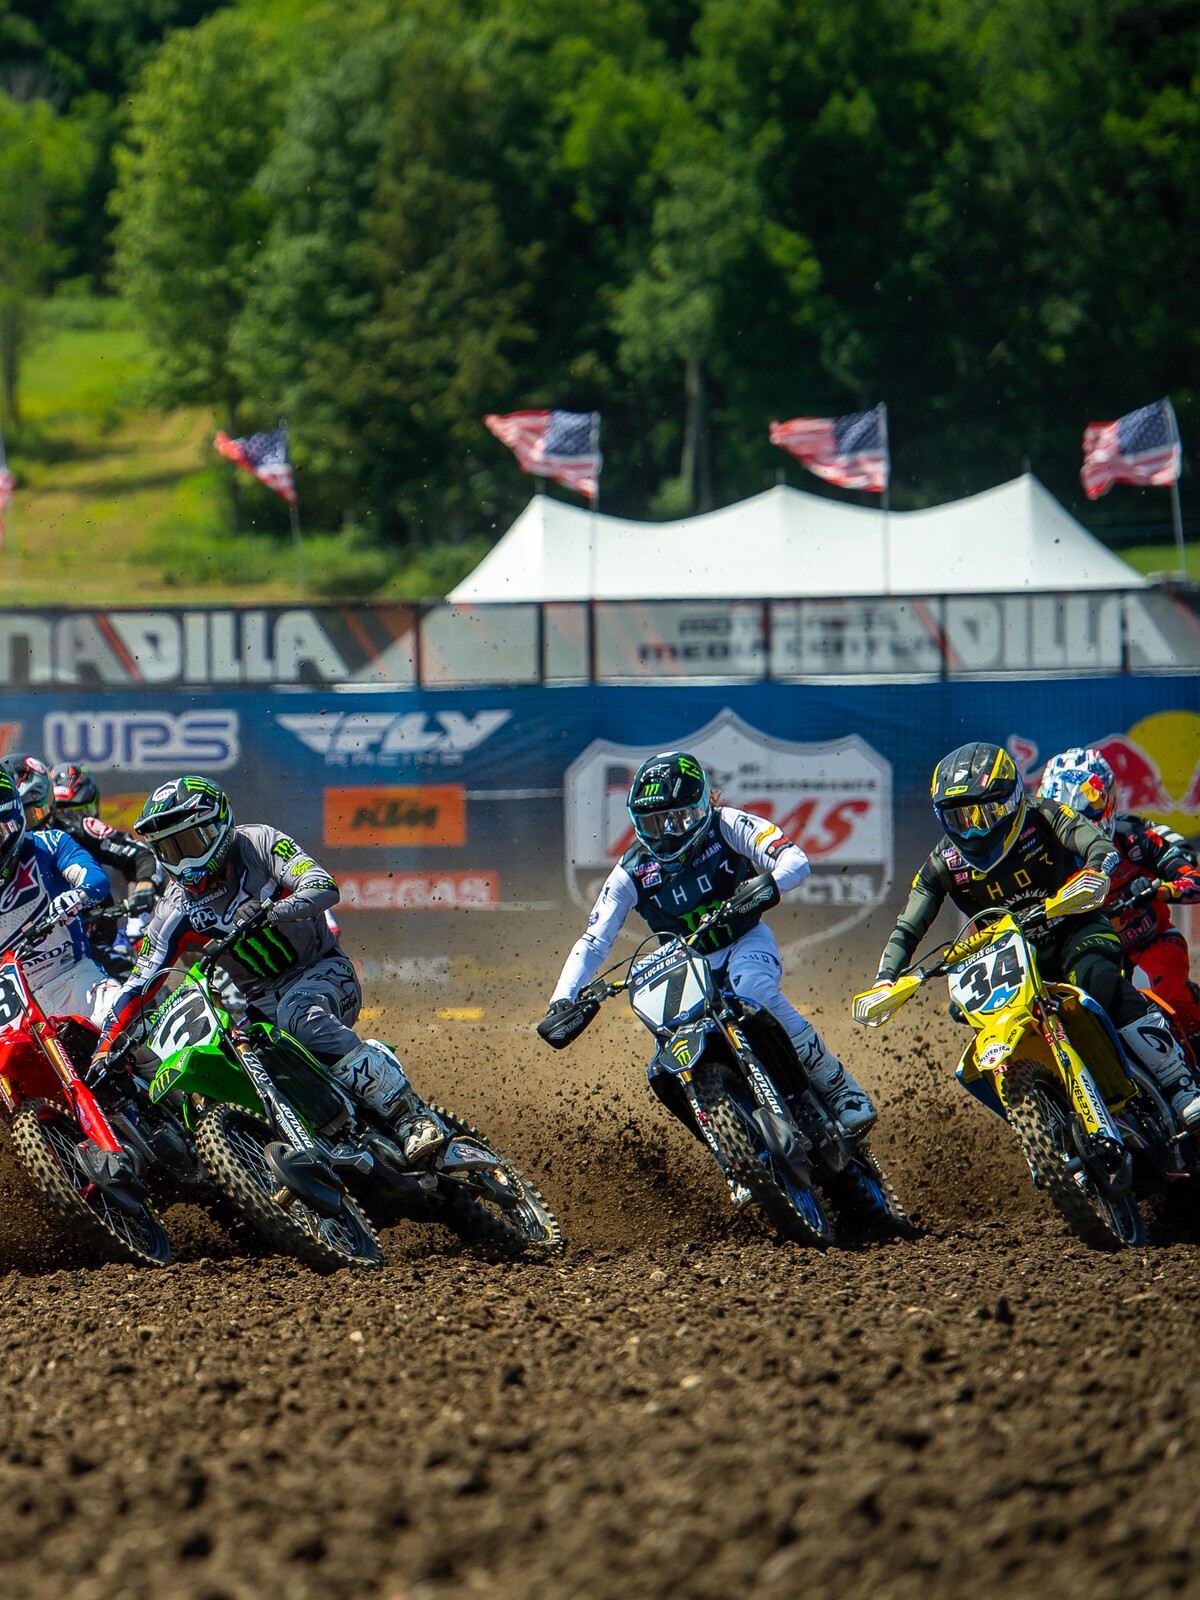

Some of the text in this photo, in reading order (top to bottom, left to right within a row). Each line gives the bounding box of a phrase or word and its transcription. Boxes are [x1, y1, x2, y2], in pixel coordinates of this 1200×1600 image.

[44, 711, 238, 772] WPS
[352, 806, 441, 829] KTM
[336, 877, 490, 909] ASGAS
[20, 940, 74, 970] ONDA
[643, 956, 678, 981] LUCAS OIL
[965, 944, 998, 967] LUCAS OIL
[649, 962, 688, 1026] 7
[959, 945, 1025, 1013] 34
[160, 996, 211, 1049] 3
[749, 1063, 783, 1115] DUNLOP
[274, 1113, 296, 1140] CARRILLO
[278, 1102, 315, 1149] DUNLOP
[689, 1098, 720, 1151] DULOP
